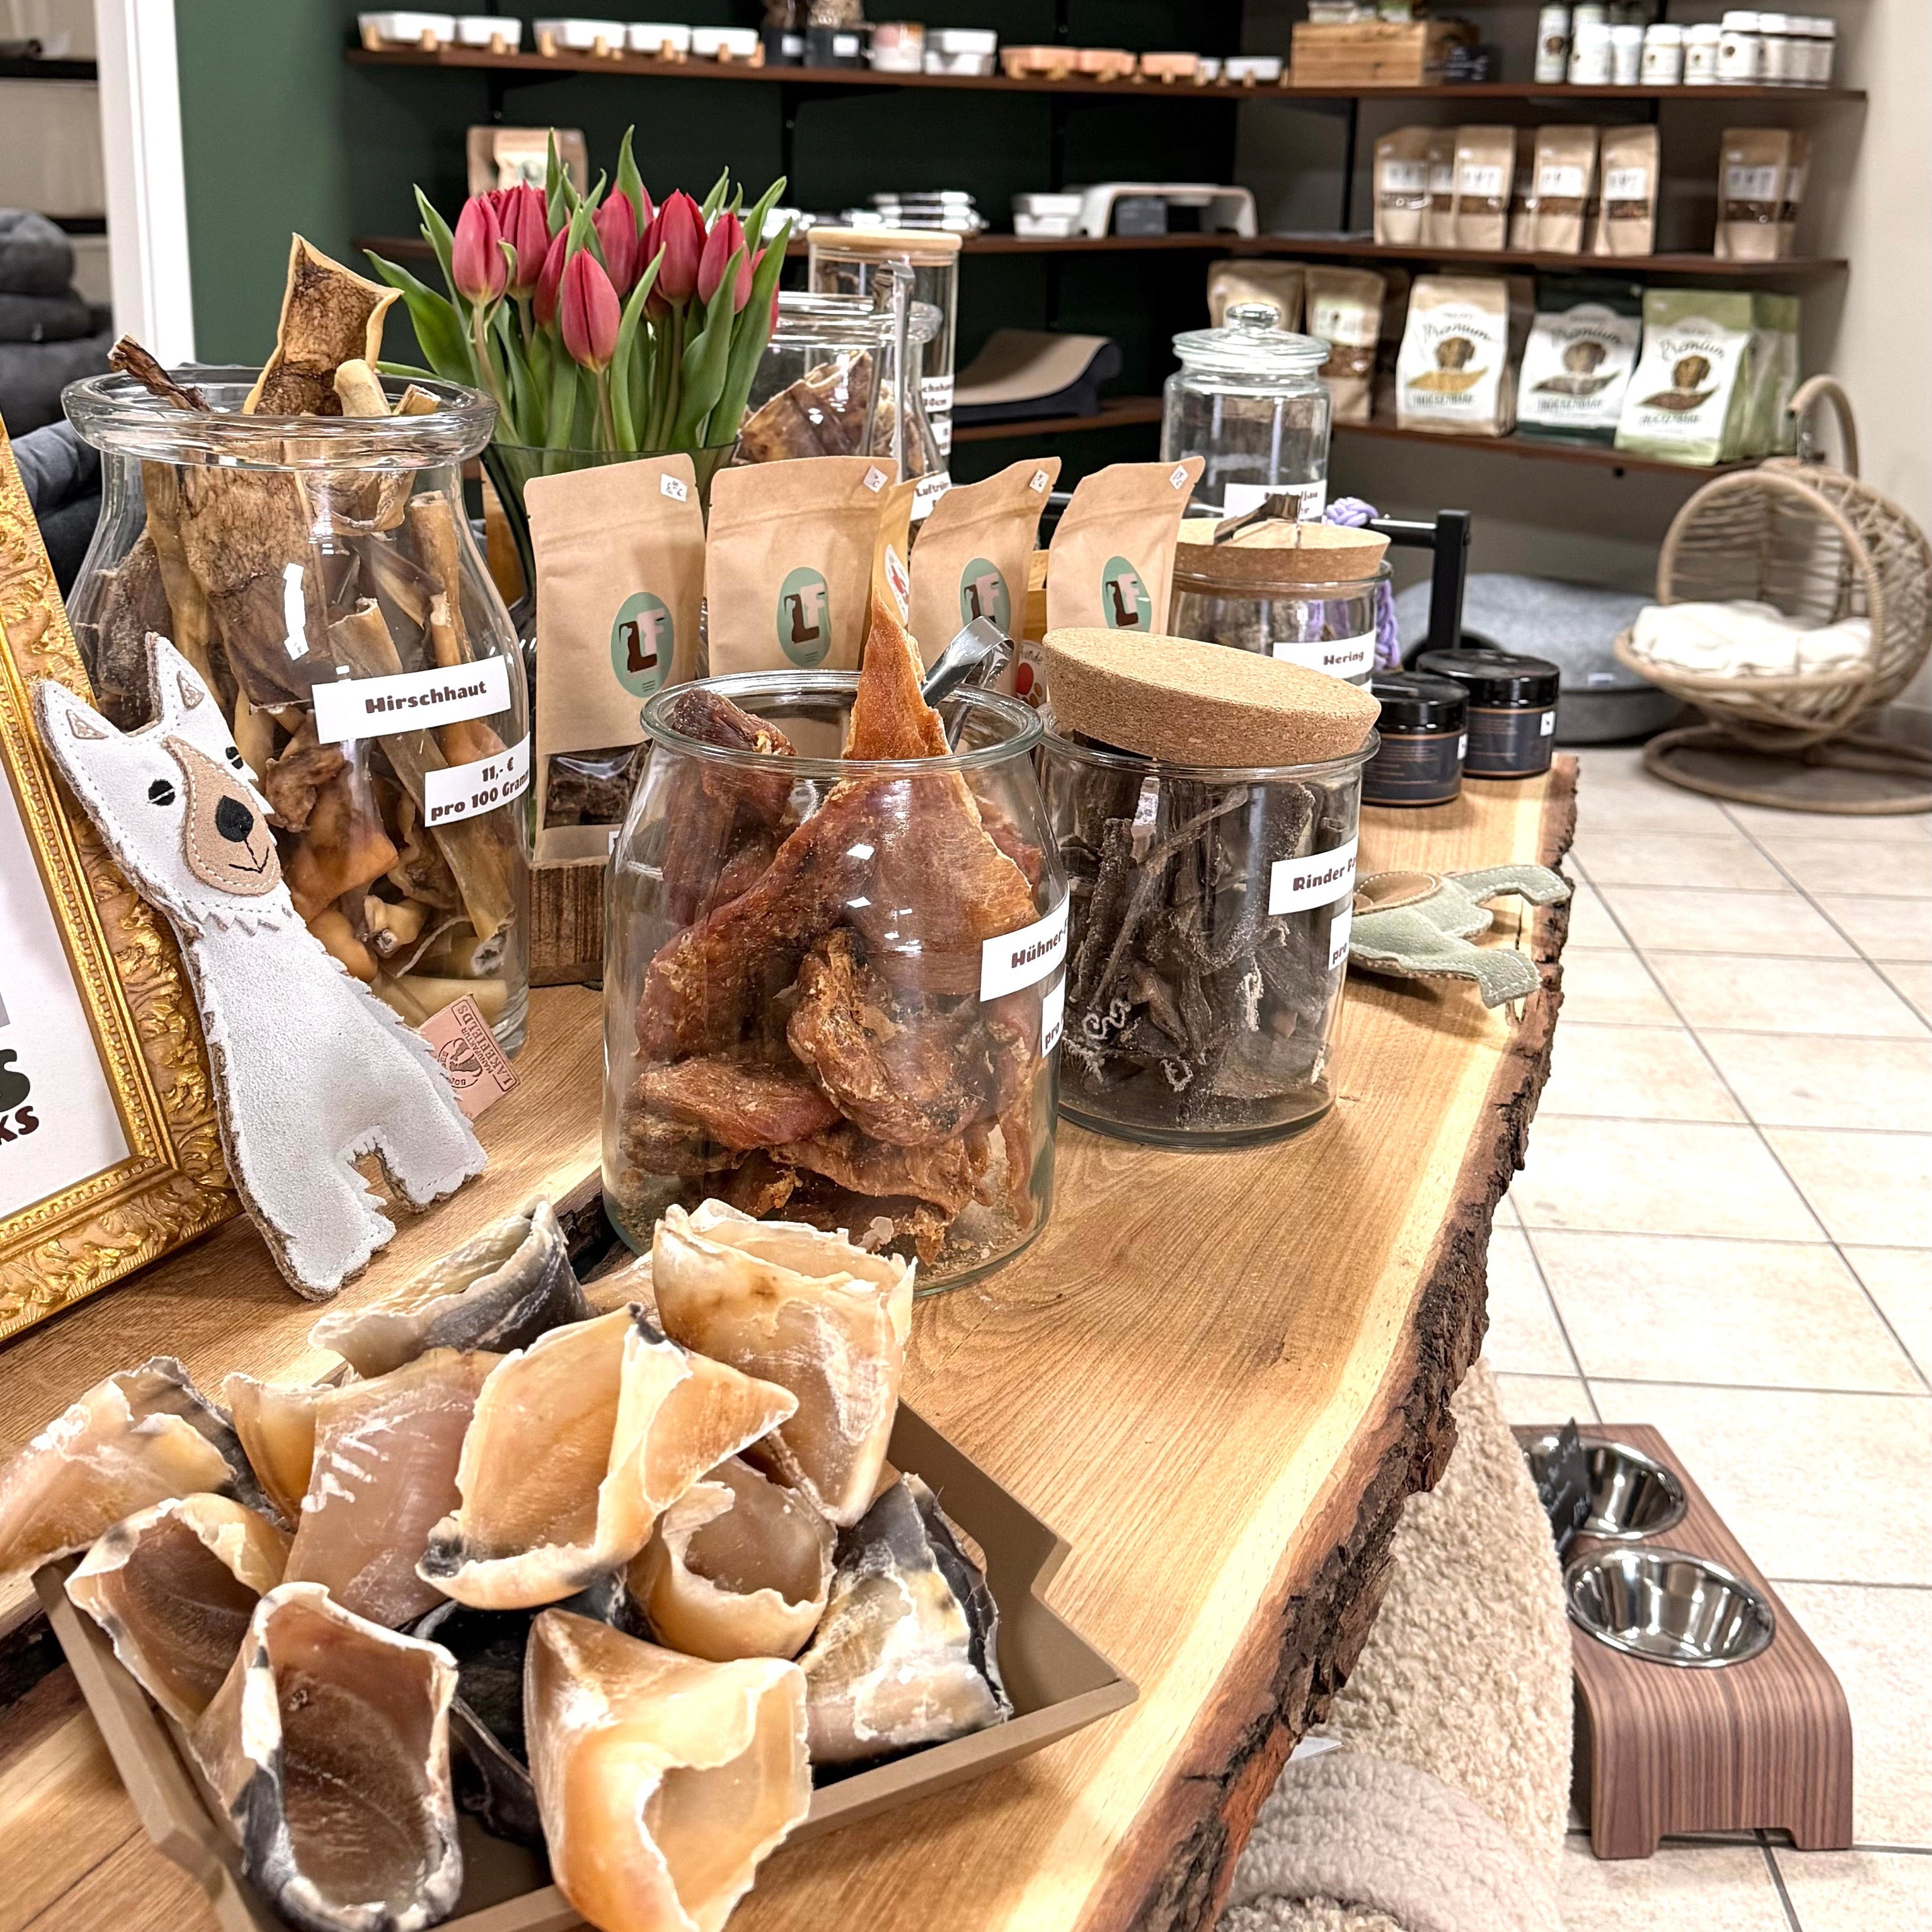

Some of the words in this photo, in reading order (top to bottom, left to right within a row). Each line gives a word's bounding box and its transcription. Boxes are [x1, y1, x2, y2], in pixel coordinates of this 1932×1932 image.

[1323, 651, 1364, 665] Hering
[365, 680, 487, 714] Hirschhaut
[430, 801, 465, 821] pro
[471, 787, 498, 808] 100
[1293, 866, 1345, 891] Rinder
[457, 1005, 513, 1086] LAKEFIELDS
